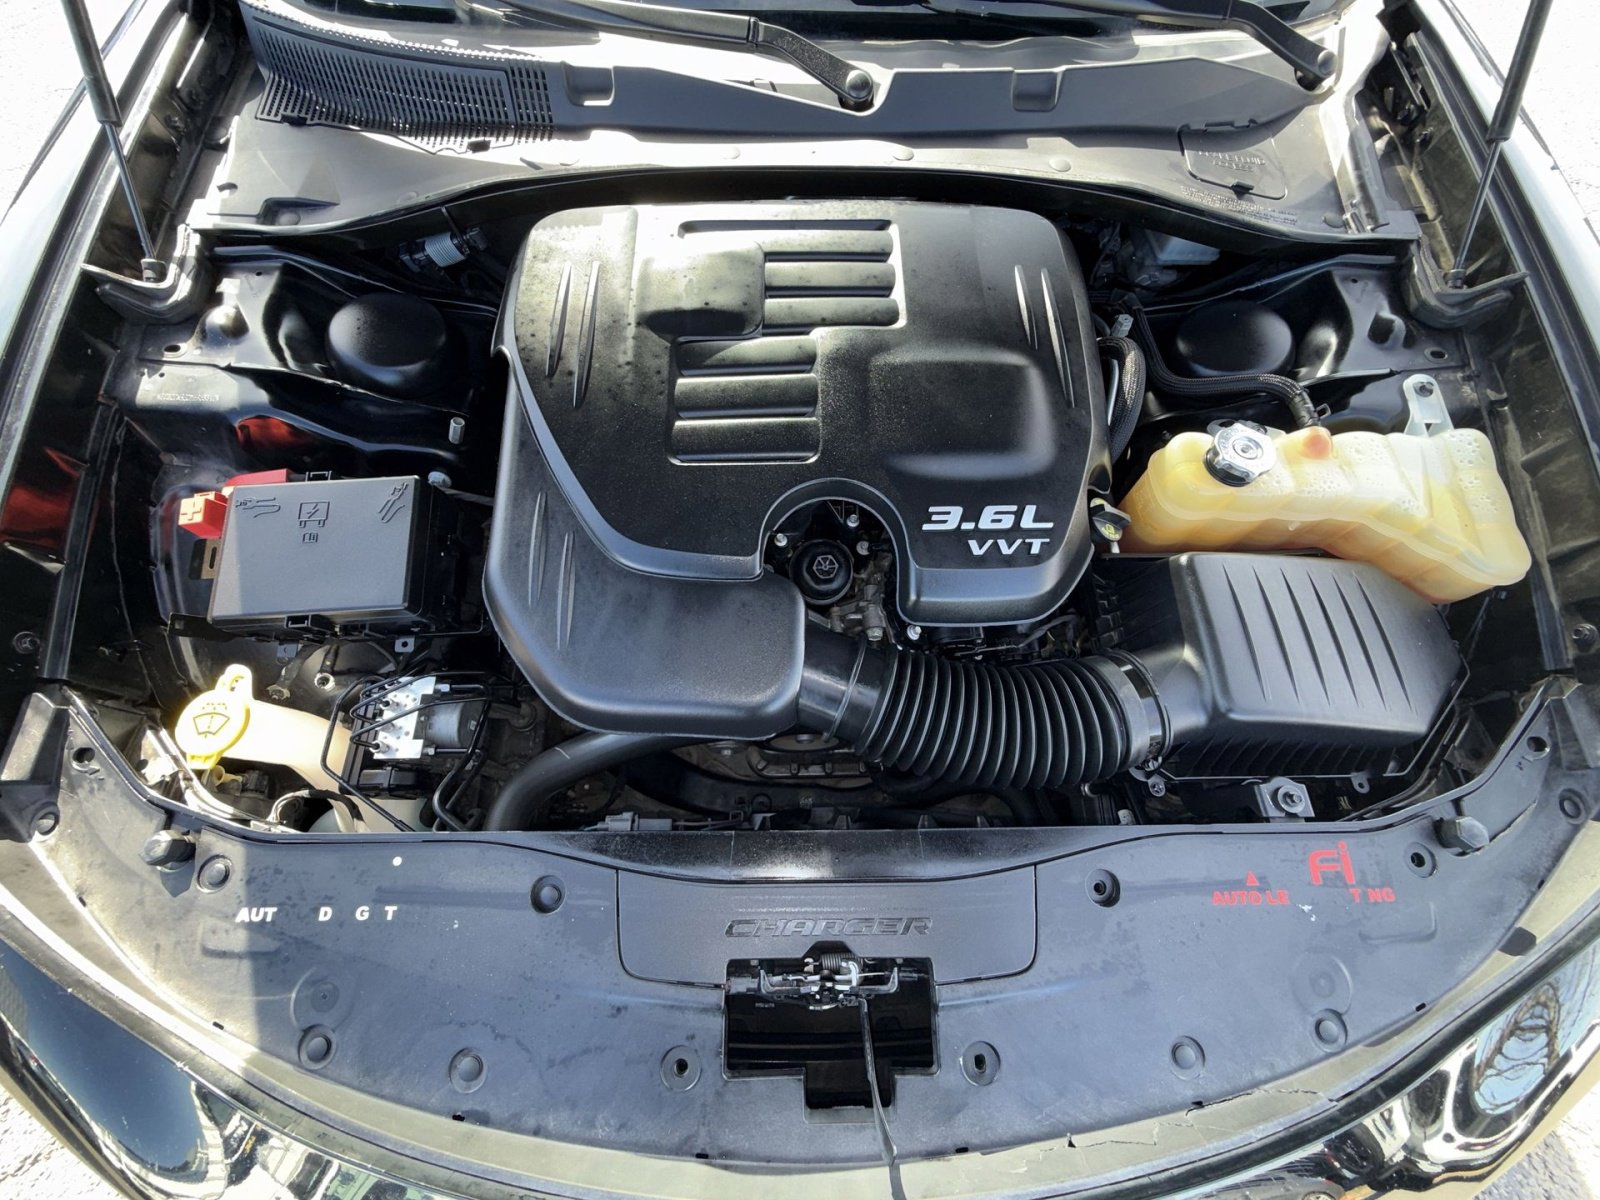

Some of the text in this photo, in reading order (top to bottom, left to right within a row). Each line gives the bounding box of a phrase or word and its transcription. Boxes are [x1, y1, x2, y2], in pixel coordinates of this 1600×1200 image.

[922, 505, 1054, 531] 3.6L
[967, 538, 1050, 556] VVT
[235, 906, 397, 923] AUT D G T
[724, 917, 933, 937] CHARGER
